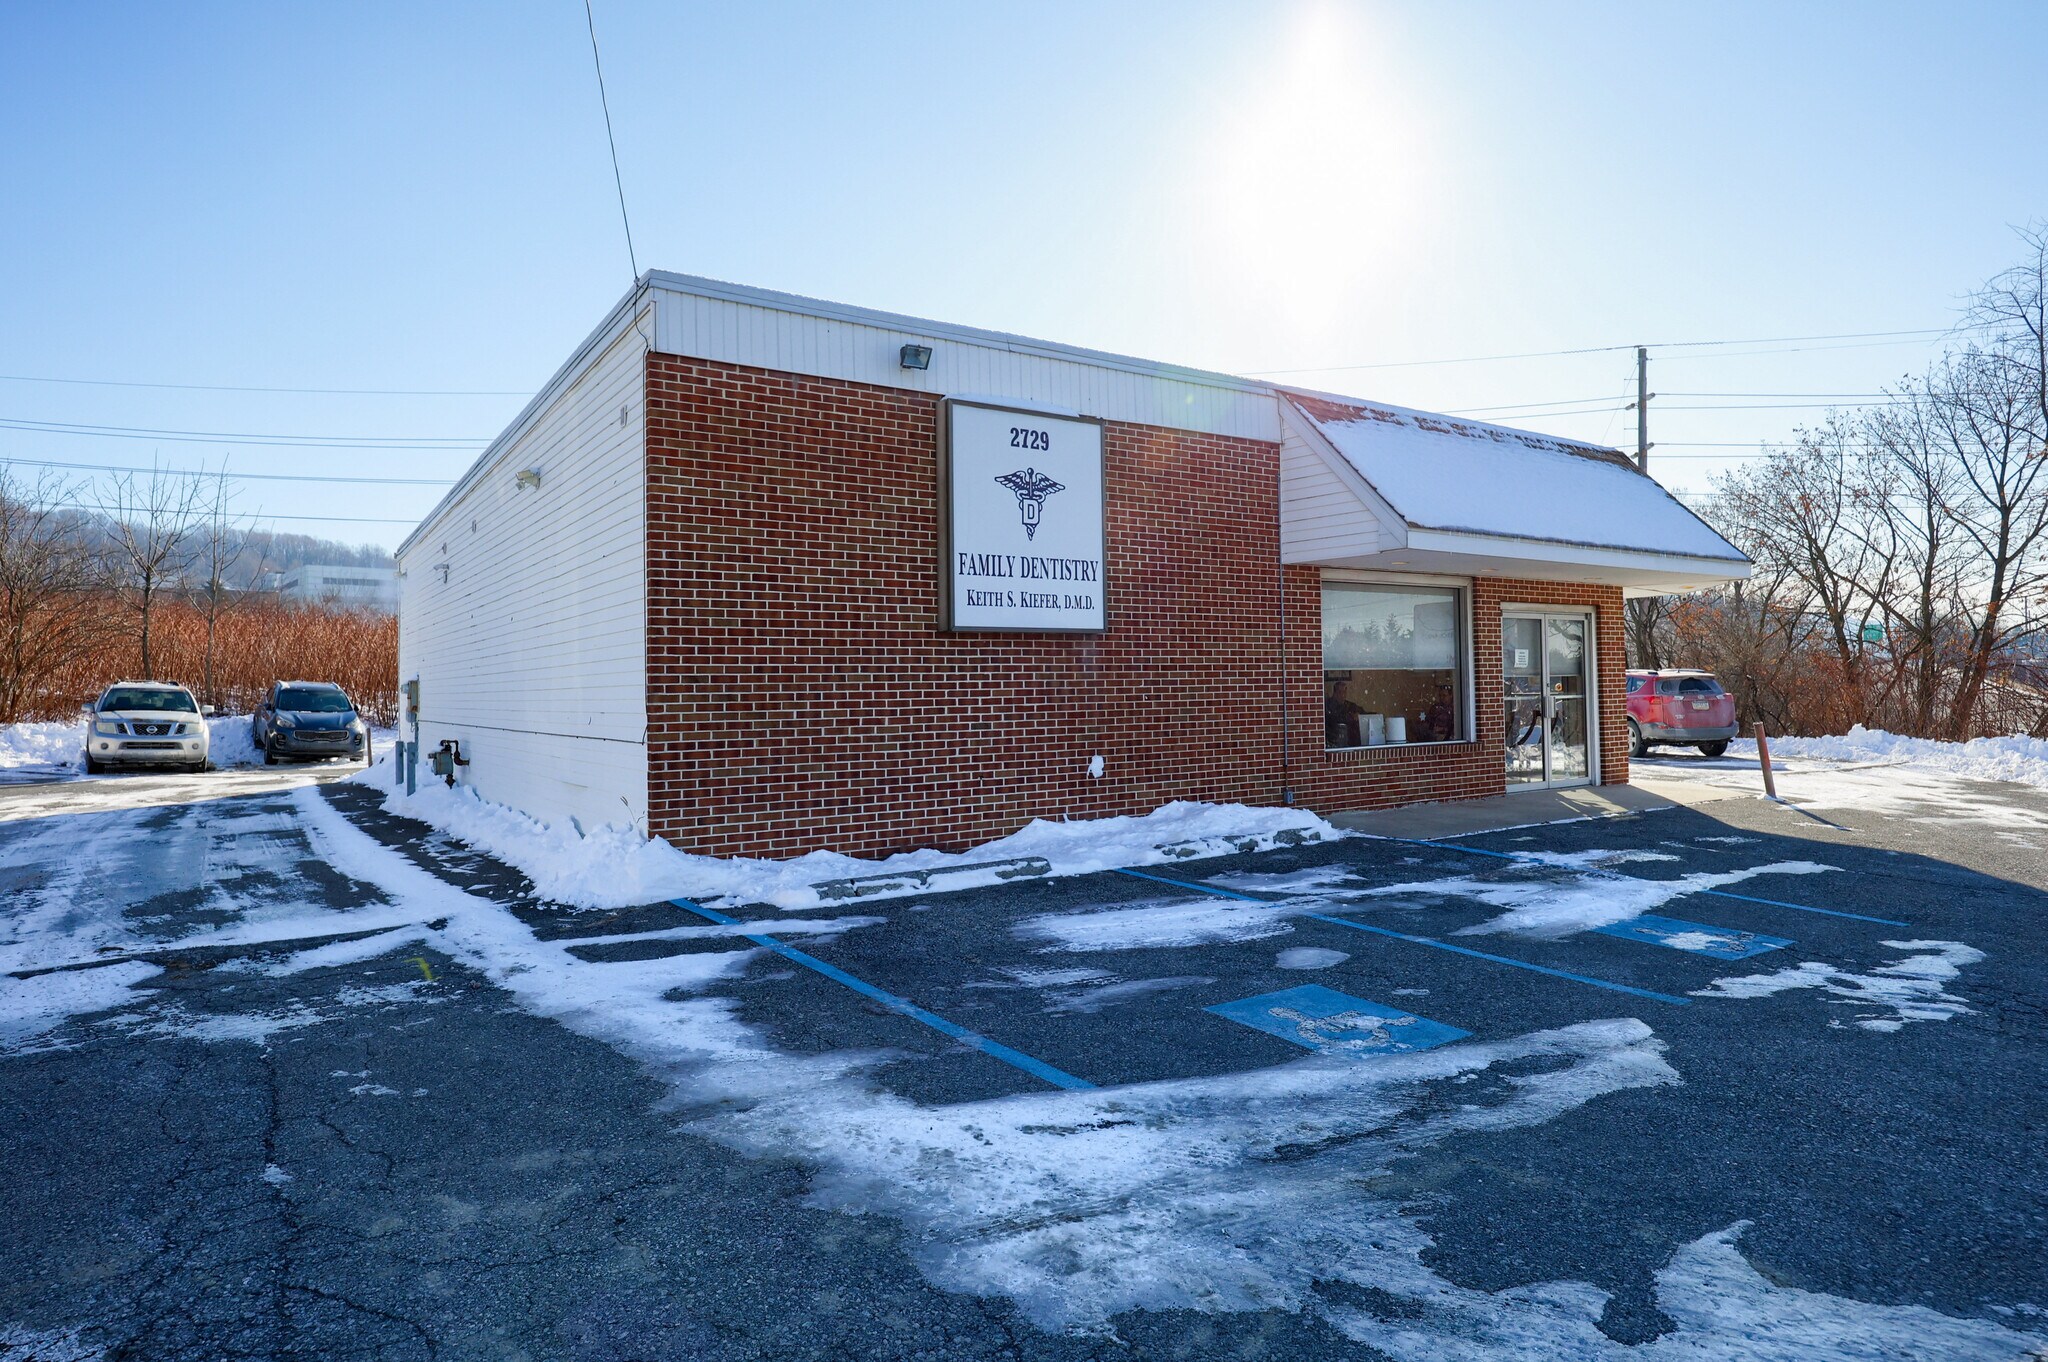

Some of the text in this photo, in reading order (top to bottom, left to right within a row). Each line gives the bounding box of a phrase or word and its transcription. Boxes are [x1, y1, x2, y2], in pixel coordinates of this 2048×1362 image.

[1010, 427, 1050, 451] 2729
[1022, 498, 1041, 525] D
[958, 552, 1099, 582] FAMILY DENTISTRY
[966, 589, 1095, 612] KEITH S. KIEFER, D.M.D.
